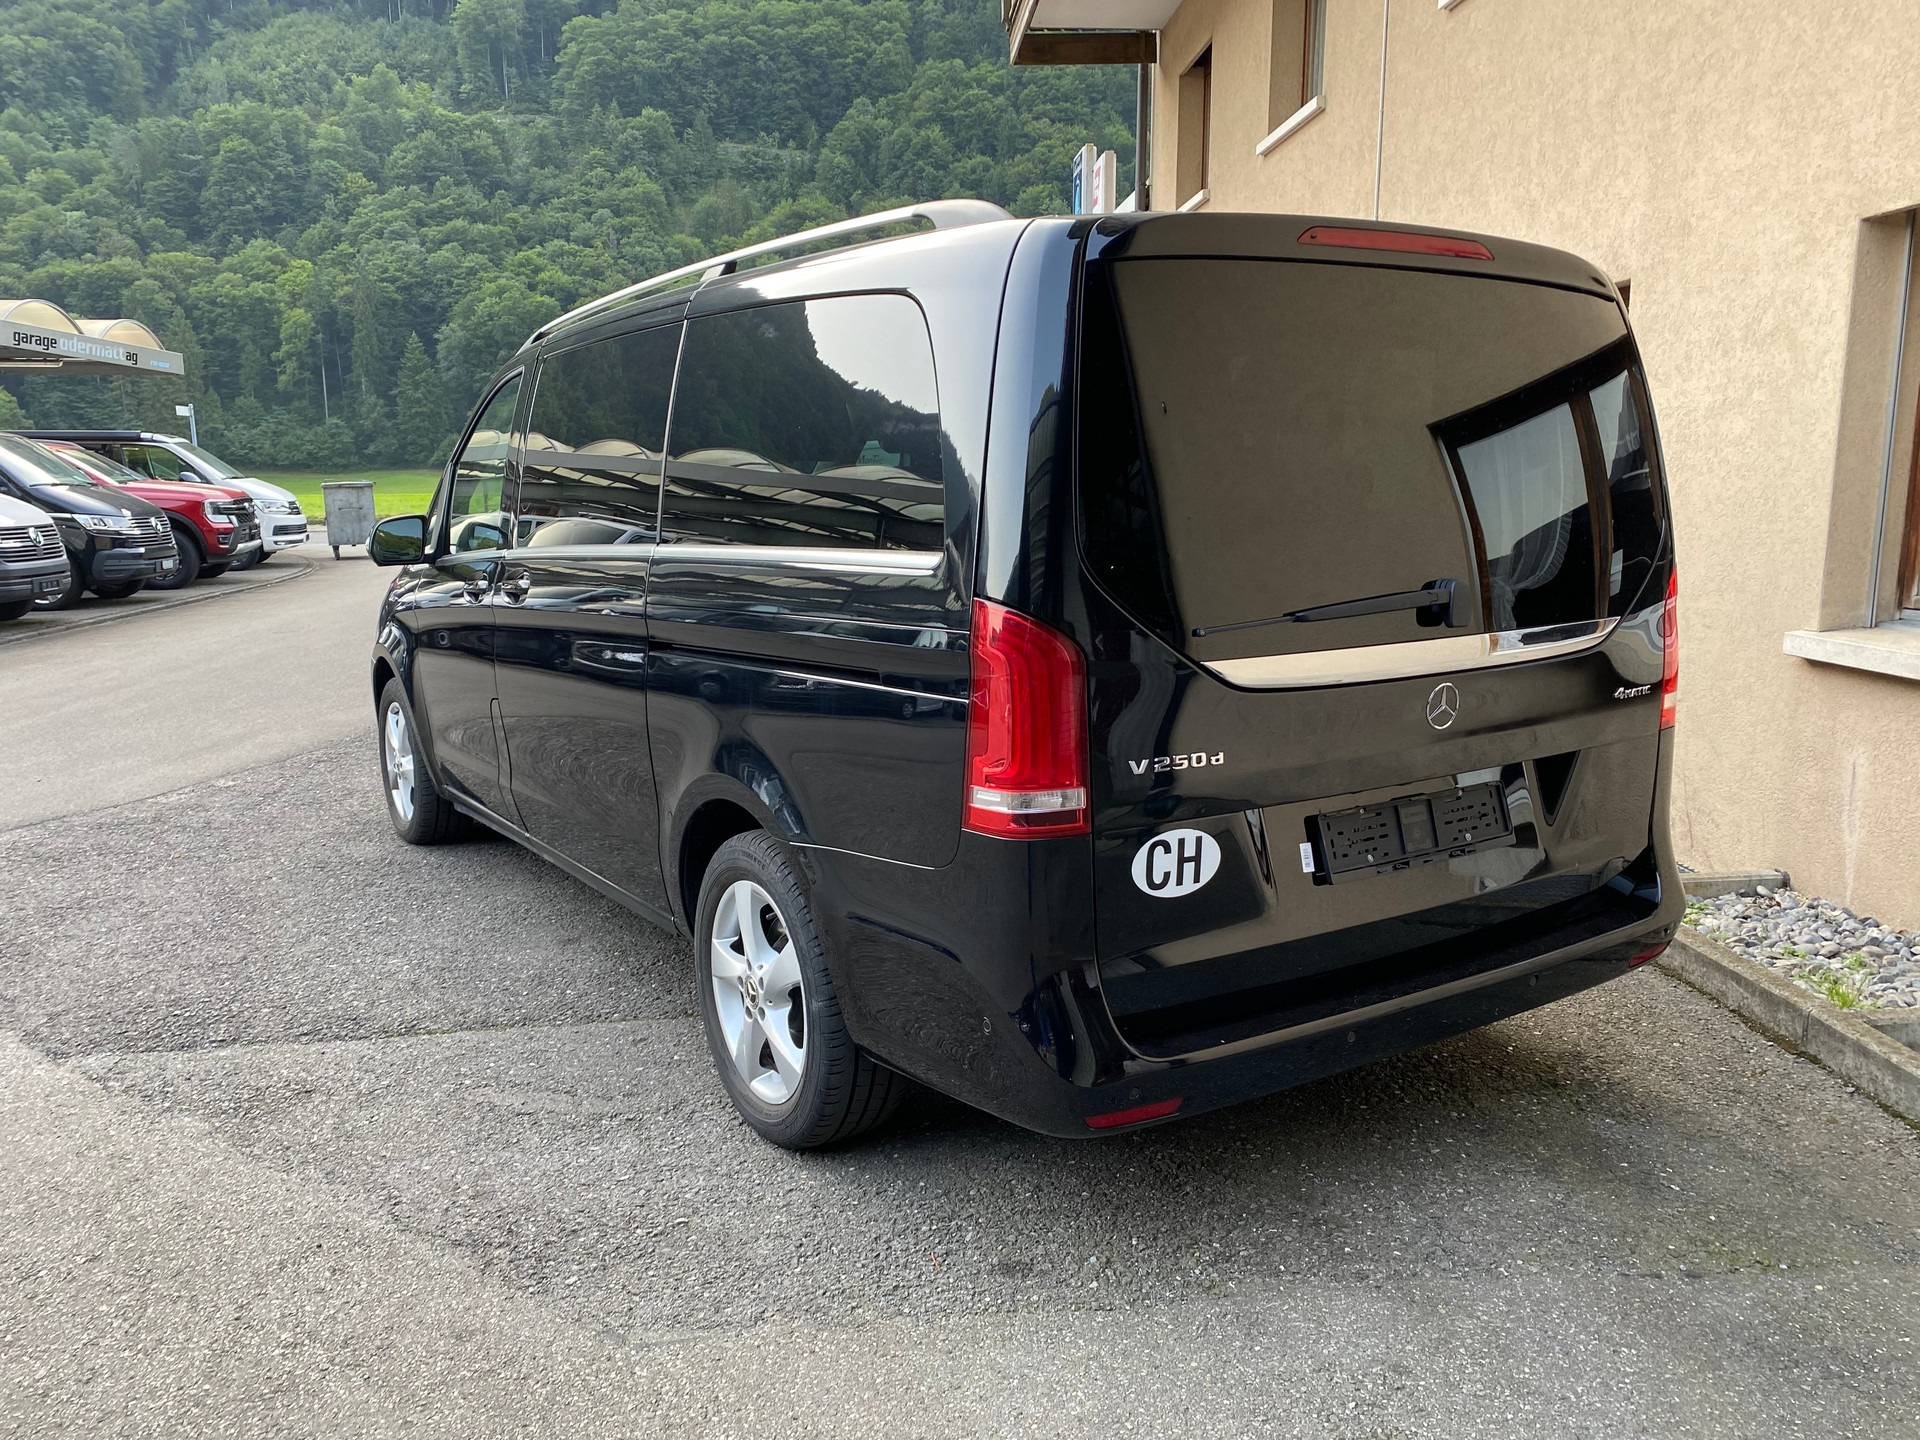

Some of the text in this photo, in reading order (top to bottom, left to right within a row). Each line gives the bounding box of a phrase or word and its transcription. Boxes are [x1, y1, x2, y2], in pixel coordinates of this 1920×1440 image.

[13, 332, 57, 351] garage
[60, 337, 125, 360] odermatt
[125, 351, 138, 365] ag
[1614, 685, 1651, 699] 4MATIC
[1145, 835, 1203, 891] CH
